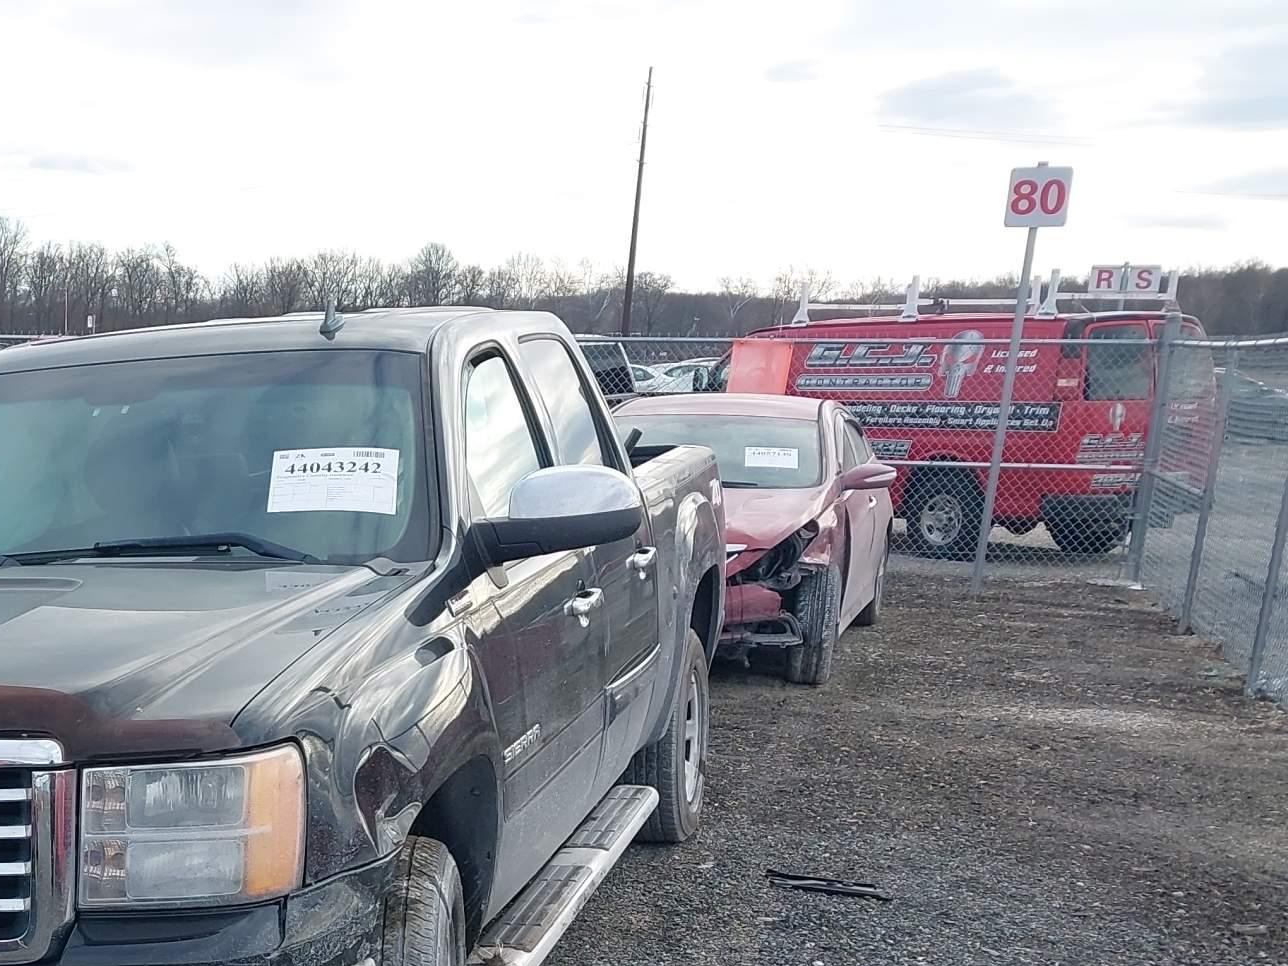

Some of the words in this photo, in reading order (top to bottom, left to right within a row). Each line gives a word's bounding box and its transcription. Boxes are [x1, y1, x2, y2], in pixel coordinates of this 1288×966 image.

[1010, 178, 1066, 215] 80
[1095, 269, 1115, 289] R
[1135, 269, 1153, 290] S
[991, 349, 1038, 358] Licsed
[983, 364, 994, 373] &
[995, 364, 1037, 373] Inred
[803, 377, 923, 388] CONTRACTOR
[889, 405, 917, 413] Decks
[925, 405, 966, 415] Flooring
[1024, 406, 1050, 415] Trim
[284, 461, 382, 475] 44043242
[503, 723, 542, 765] SIERRA
